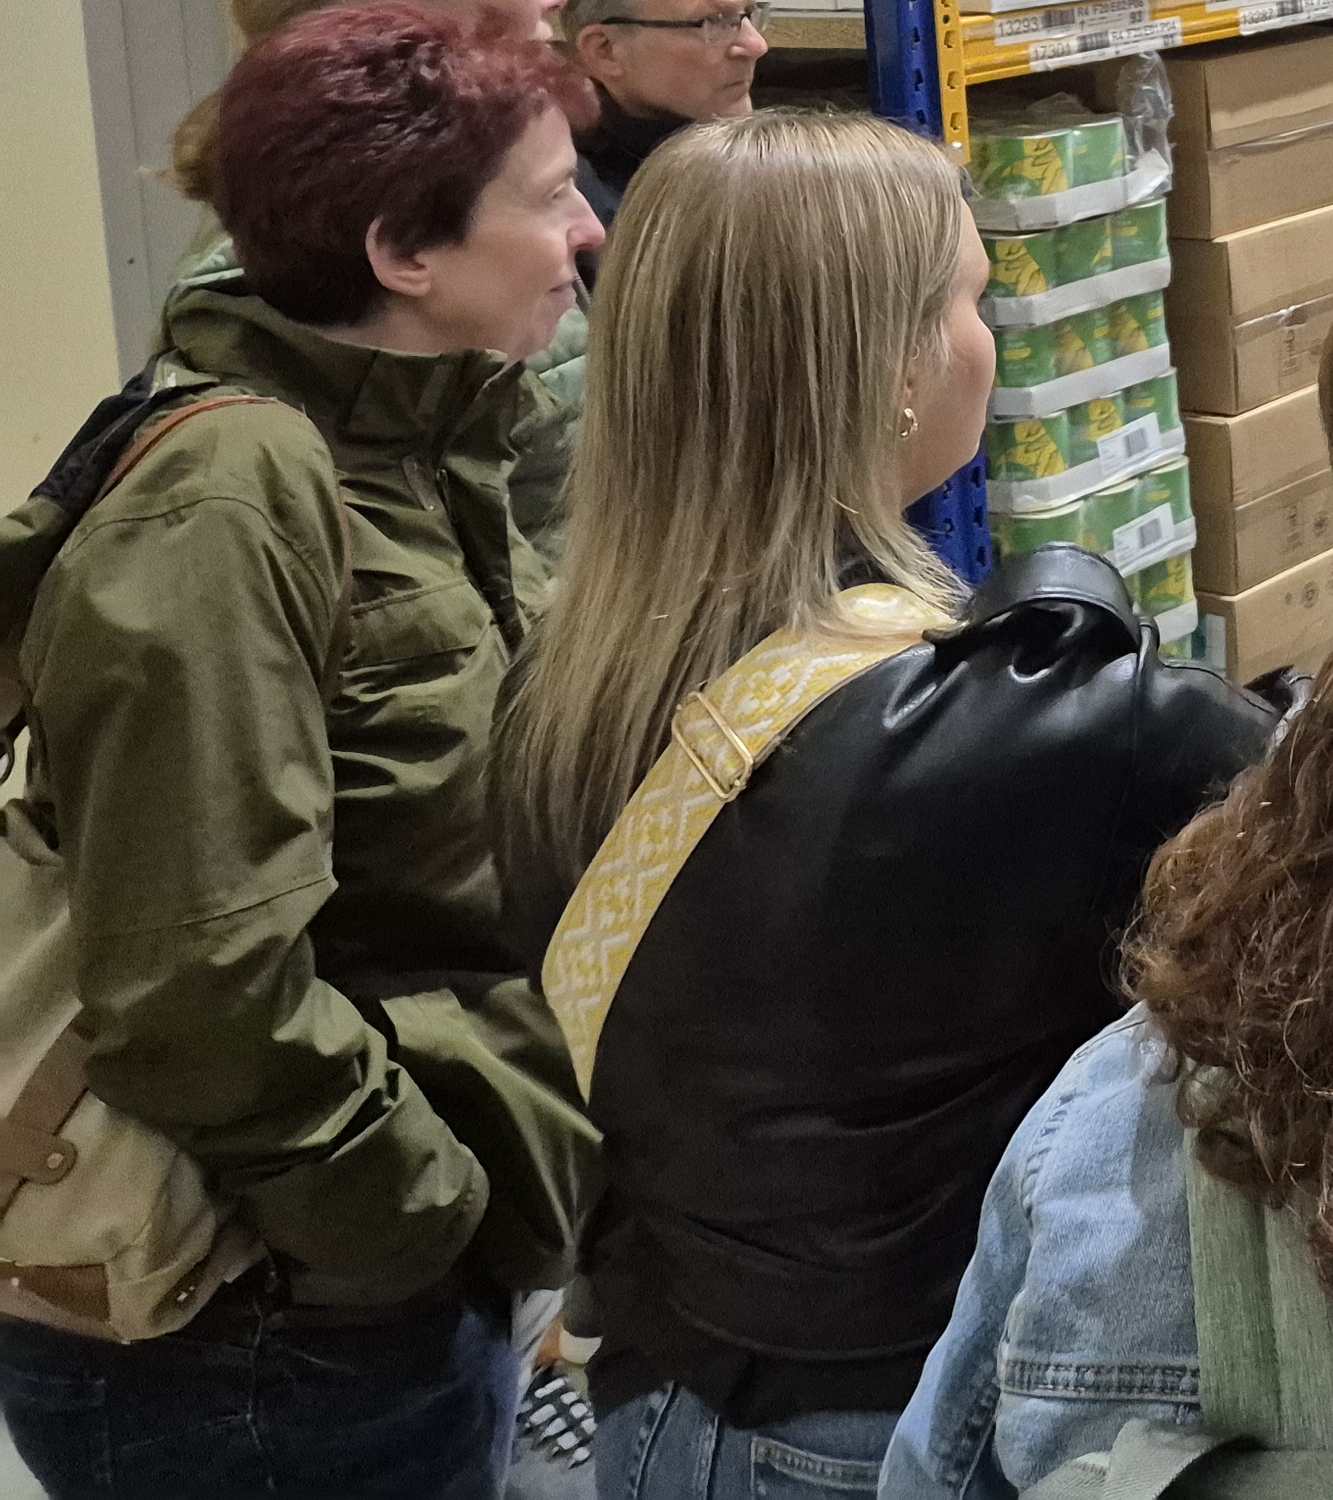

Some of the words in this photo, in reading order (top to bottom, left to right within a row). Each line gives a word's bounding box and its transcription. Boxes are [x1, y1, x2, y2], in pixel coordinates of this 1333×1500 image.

[997, 17, 1039, 37] 13293
[1077, 7, 1090, 17] R4
[1094, 4, 1110, 15] F20
[1111, 1, 1128, 12] E02
[1129, 11, 1143, 24] 93
[1033, 43, 1071, 61] 17301
[1111, 31, 1124, 42] R4
